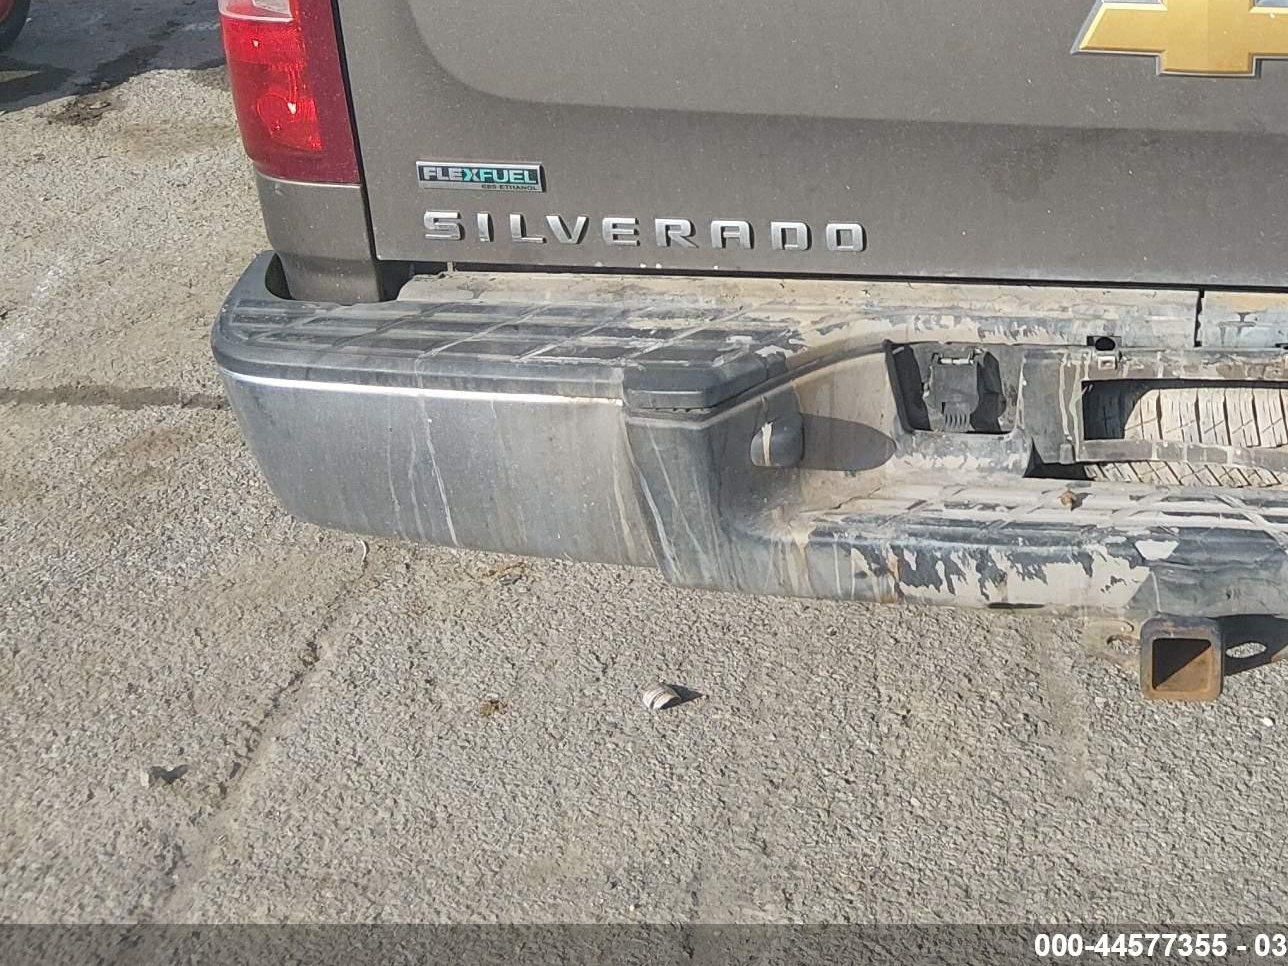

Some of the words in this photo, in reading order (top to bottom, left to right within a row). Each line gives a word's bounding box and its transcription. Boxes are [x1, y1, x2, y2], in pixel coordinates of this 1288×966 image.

[422, 166, 537, 184] FLEXFUEL
[499, 184, 540, 192] ETHANOL
[423, 210, 866, 252] SILVERADO
